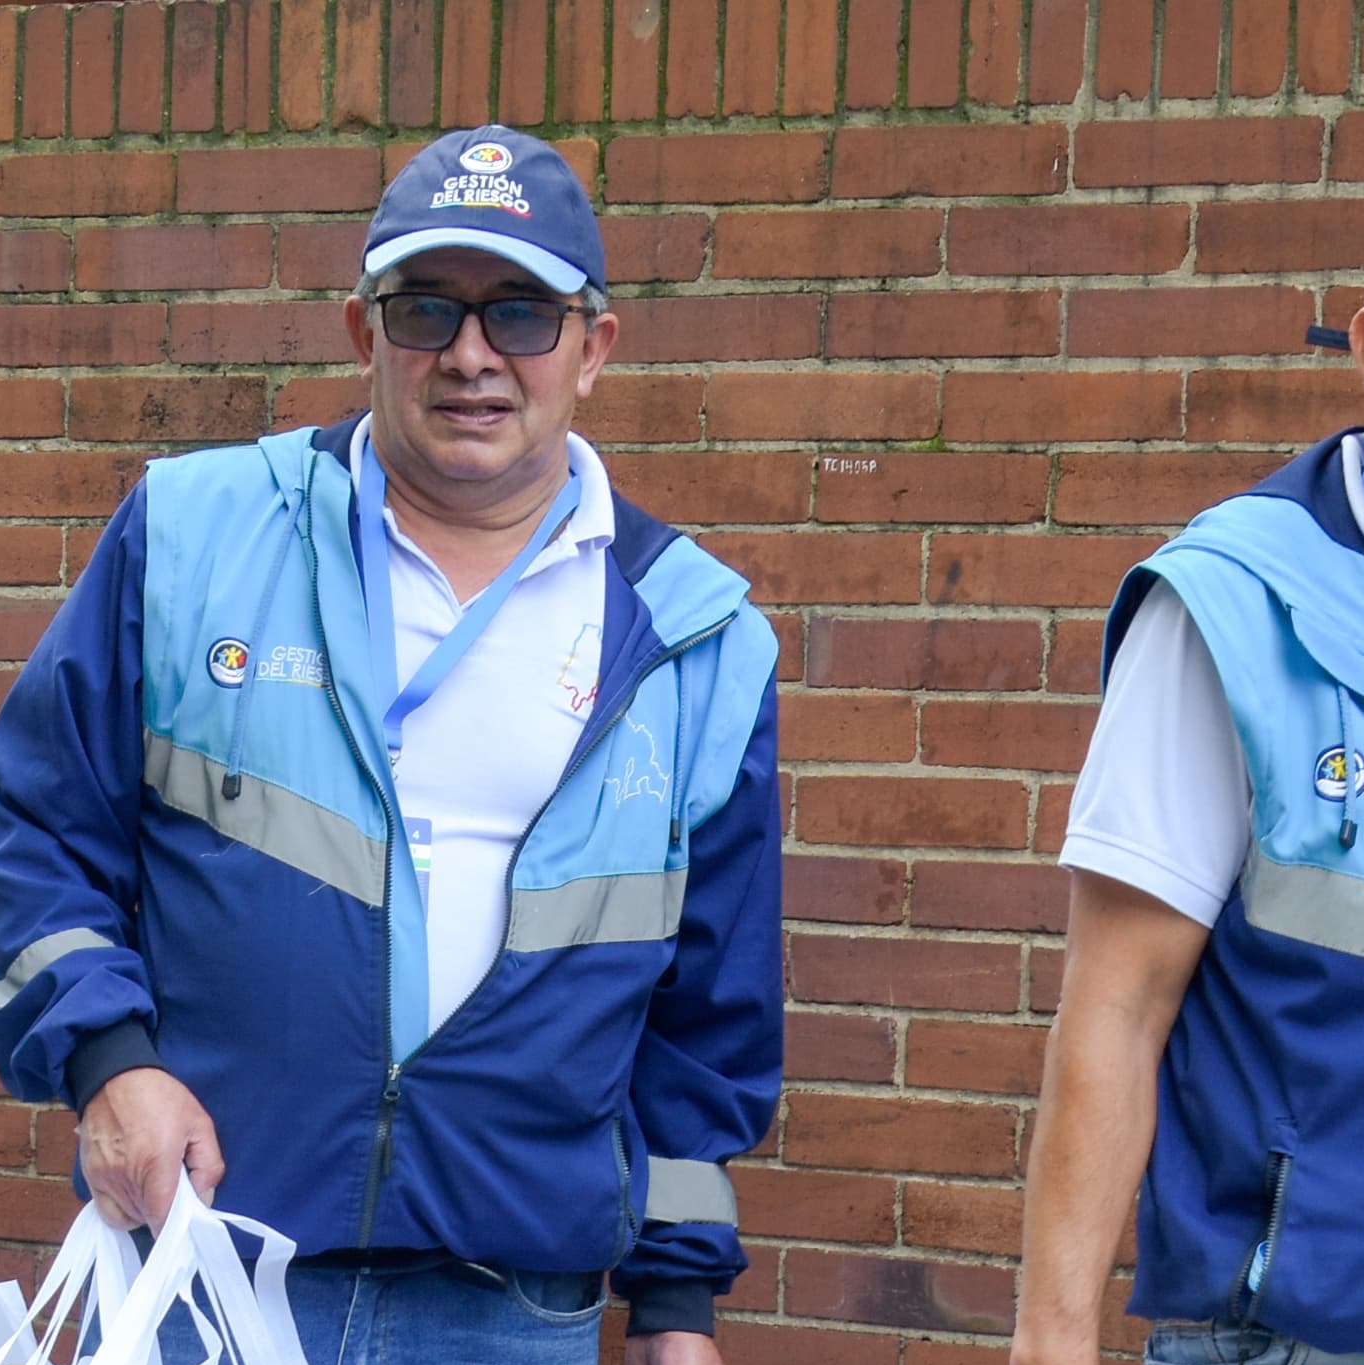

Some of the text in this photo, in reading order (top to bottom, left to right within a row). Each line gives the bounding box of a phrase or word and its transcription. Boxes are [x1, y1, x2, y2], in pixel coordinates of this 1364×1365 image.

[444, 174, 522, 198] GESTIÓN
[432, 188, 530, 214] DEL RIESGO
[258, 661, 324, 682] DEL RIES
[412, 829, 420, 840] 4
